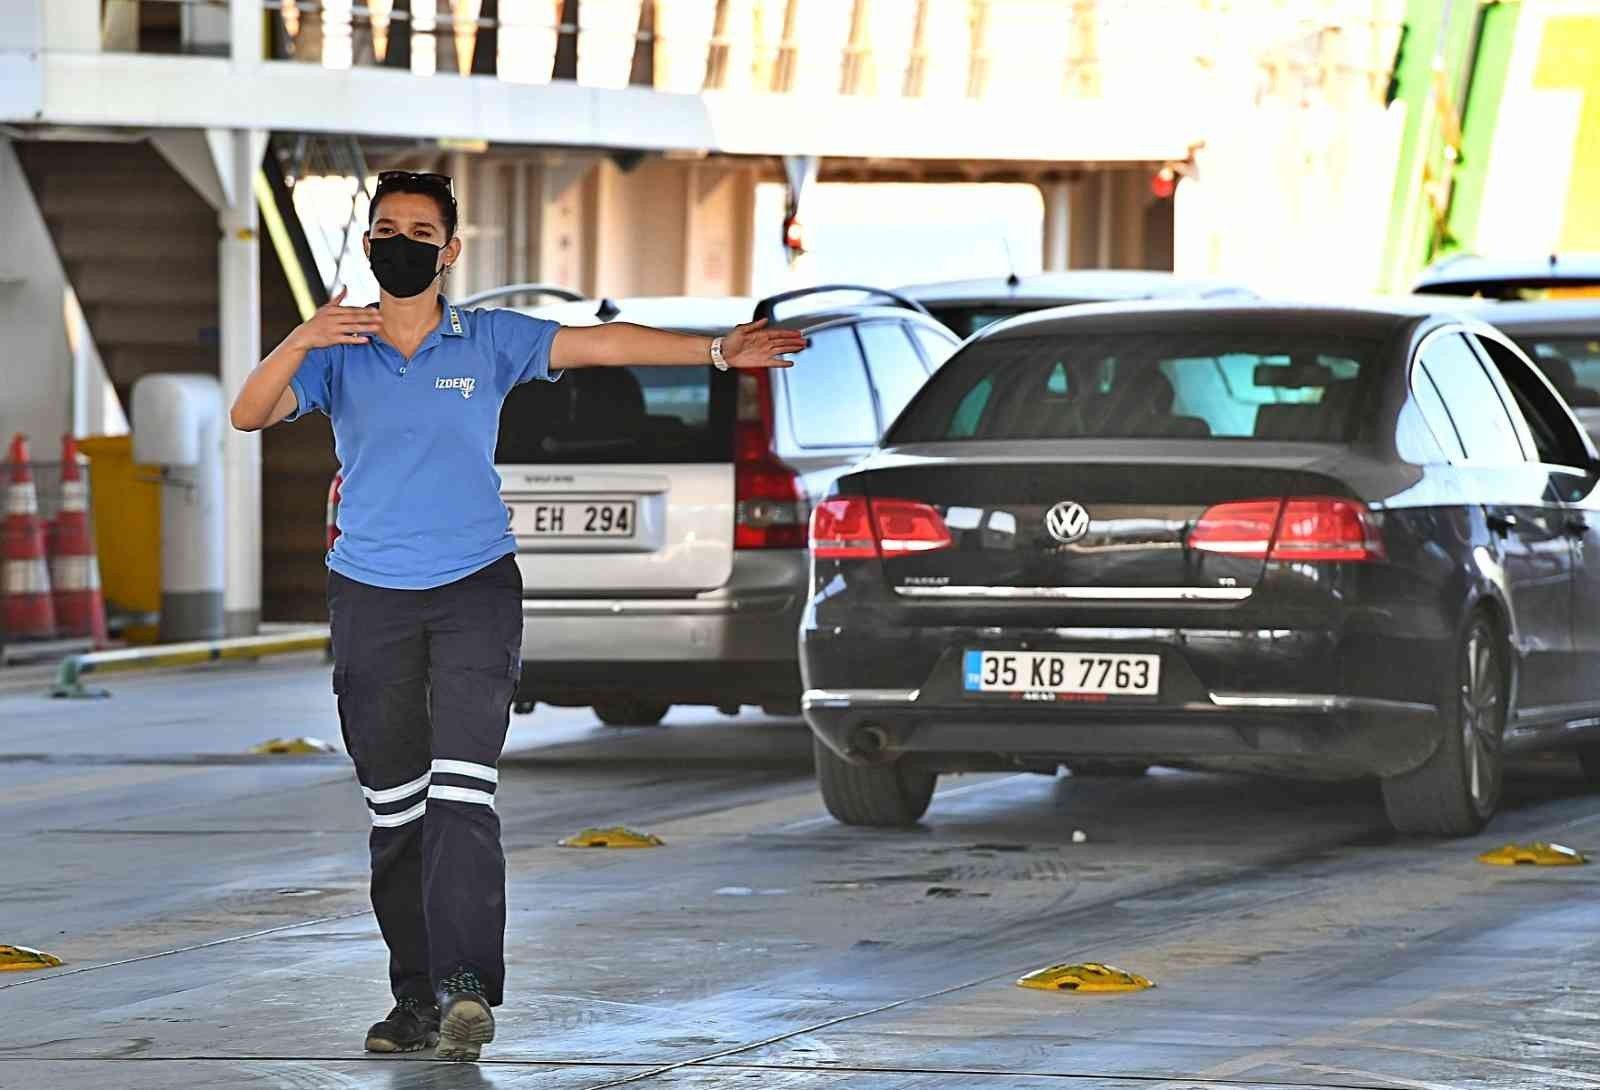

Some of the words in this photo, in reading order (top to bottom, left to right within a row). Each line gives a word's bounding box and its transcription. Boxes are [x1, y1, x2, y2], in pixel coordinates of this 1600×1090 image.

[535, 506, 564, 532] EH
[584, 506, 629, 532] 294
[984, 656, 1017, 686] 35
[1030, 657, 1065, 687] KB
[1079, 658, 1150, 689] 7763
